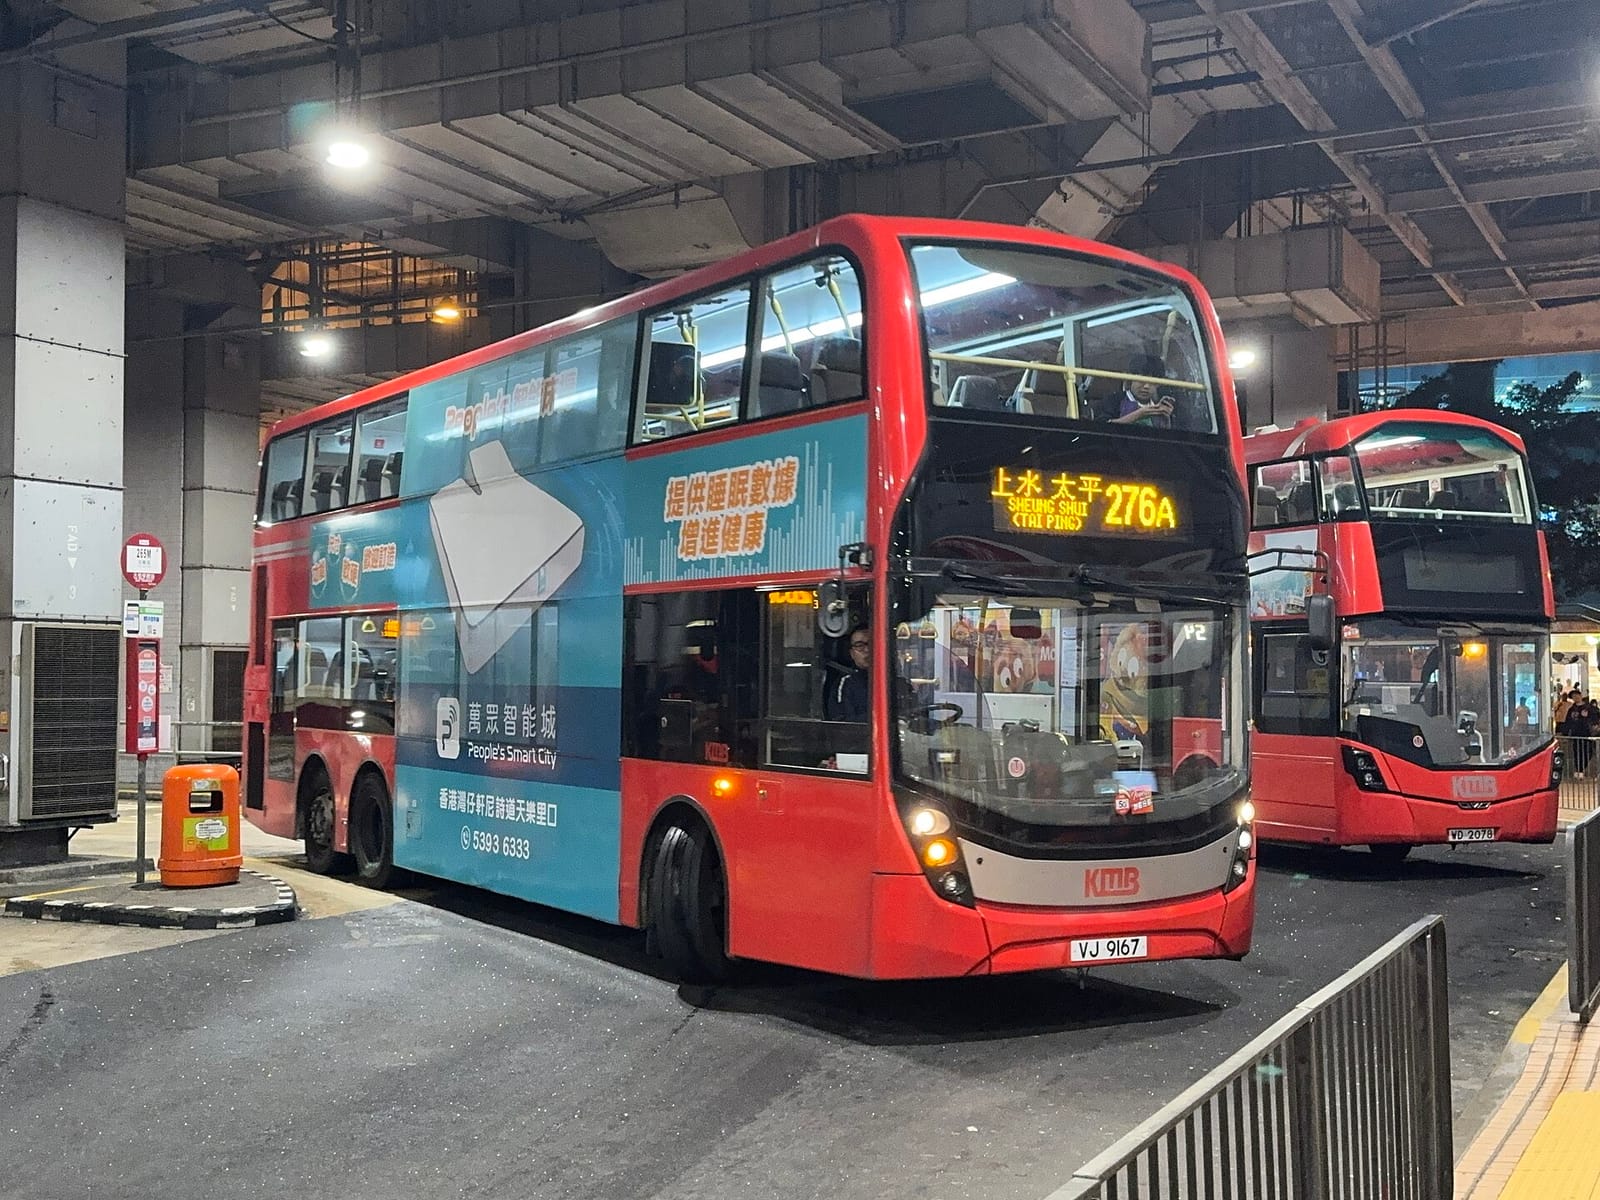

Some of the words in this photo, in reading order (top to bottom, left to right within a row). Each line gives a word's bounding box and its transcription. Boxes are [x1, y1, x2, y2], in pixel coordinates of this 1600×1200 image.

[665, 457, 798, 521] 提供睡眠數據
[991, 467, 1042, 497] 上水
[1051, 473, 1102, 503] 太平
[1008, 496, 1055, 514] SHEUNG
[1058, 499, 1088, 517] SHUI
[1105, 484, 1176, 528] 276A
[680, 510, 767, 560] 增進健康
[1012, 513, 1042, 528] (TAI
[1047, 514, 1082, 531] PING)
[468, 702, 556, 739] 萬眾智能城
[467, 742, 505, 763] People's
[507, 745, 537, 764] Smart
[538, 748, 557, 770] City
[704, 741, 729, 763] KMB
[439, 787, 558, 827] 香港灣仔軒尼詩道天樂里口
[472, 830, 500, 854] 5393
[502, 836, 530, 860] 6333
[1451, 830, 1464, 840] WD
[1467, 829, 1493, 840] 2078
[1084, 866, 1140, 898] KMB
[1079, 941, 1100, 959] VJ
[1106, 938, 1140, 957] 9167
